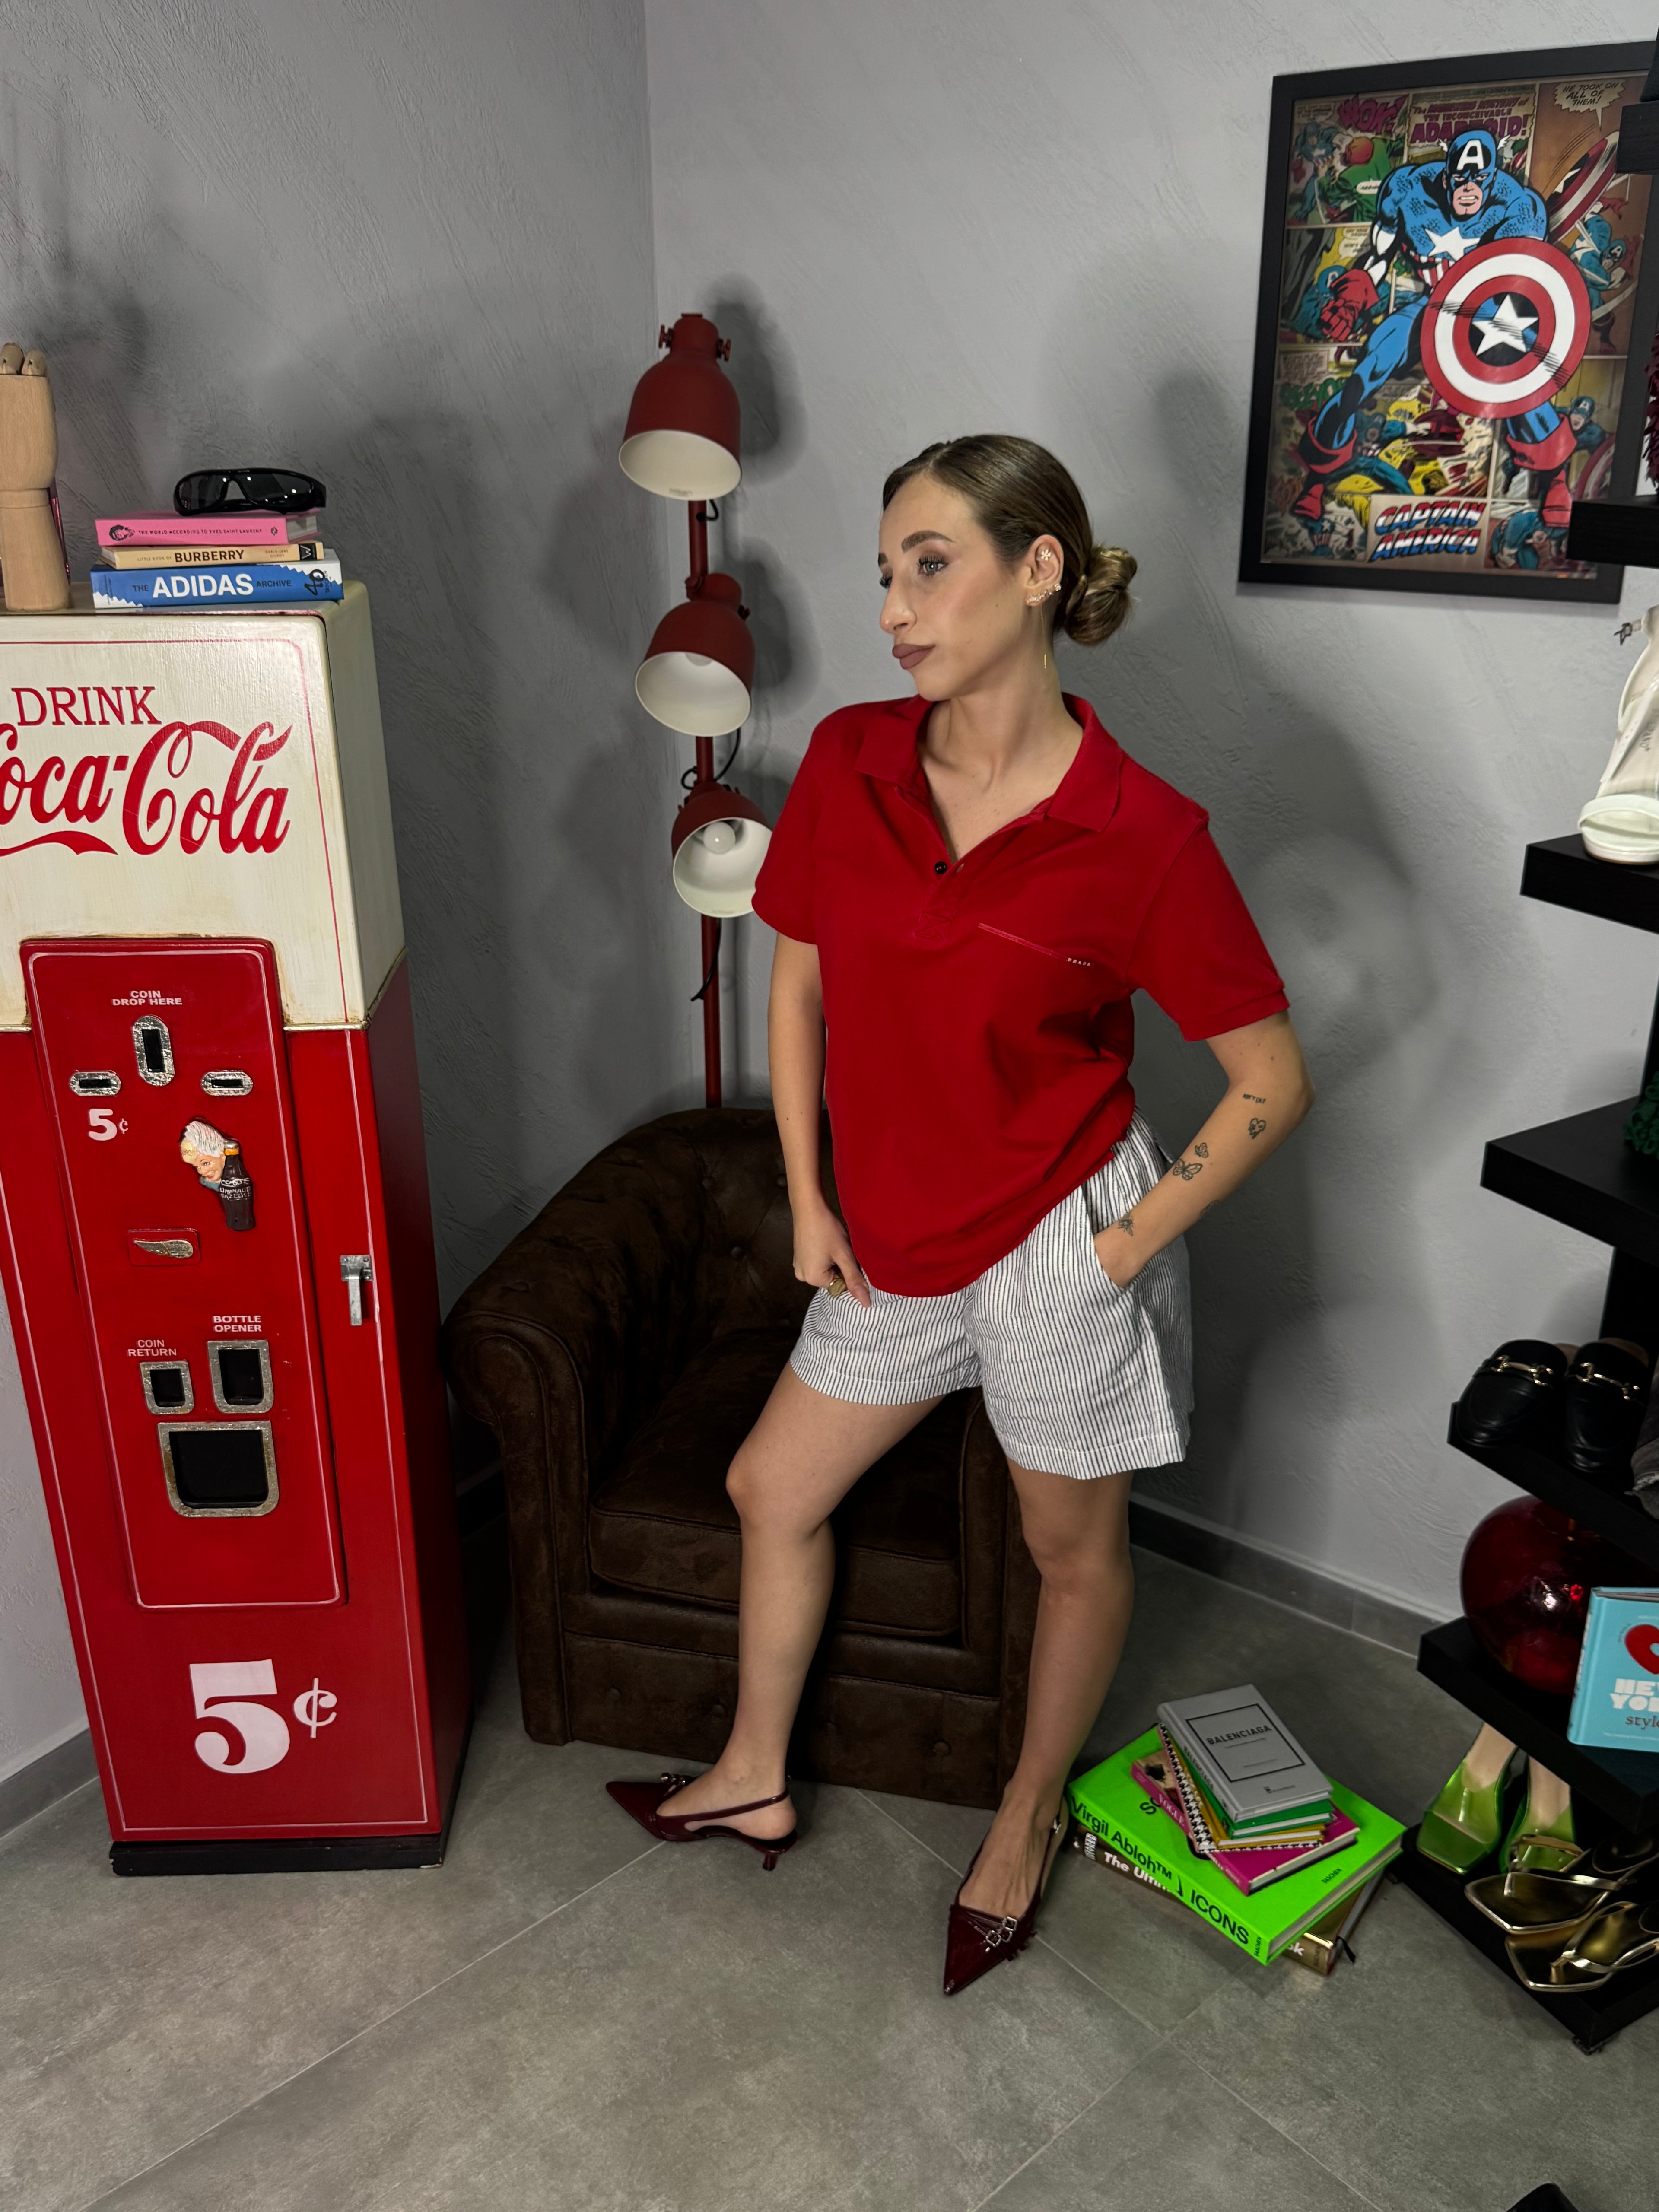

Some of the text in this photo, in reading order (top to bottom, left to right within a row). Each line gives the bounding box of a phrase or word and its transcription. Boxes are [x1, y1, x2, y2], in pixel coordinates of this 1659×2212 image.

[1566, 89, 1605, 99] ALL OF
[1579, 83, 1603, 91] TOOK
[1573, 96, 1602, 106] THEM!
[1456, 140, 1484, 170] A
[1375, 500, 1487, 535] CAPTAIN
[1367, 528, 1481, 563] AMERICA
[174, 550, 245, 563] BURBERRY
[153, 573, 254, 598] ADIDAS
[11, 686, 162, 726] DRINK
[1068, 957, 1091, 967] PRADA
[130, 990, 161, 998] COIN
[88, 1108, 128, 1141] 5¢
[213, 1315, 262, 1323] BOTTLE
[214, 1324, 262, 1332] OPENER
[127, 1348, 177, 1357] RETURN
[137, 1339, 165, 1348] COIN
[1614, 1678, 1659, 1696] NE
[190, 1659, 337, 1774] 5¢
[1206, 1725, 1273, 1745] BALENCIAGA
[1071, 1795, 1109, 1837] Virgil
[1190, 1889, 1249, 1945] ICONS
[1104, 1851, 1130, 1872] The
